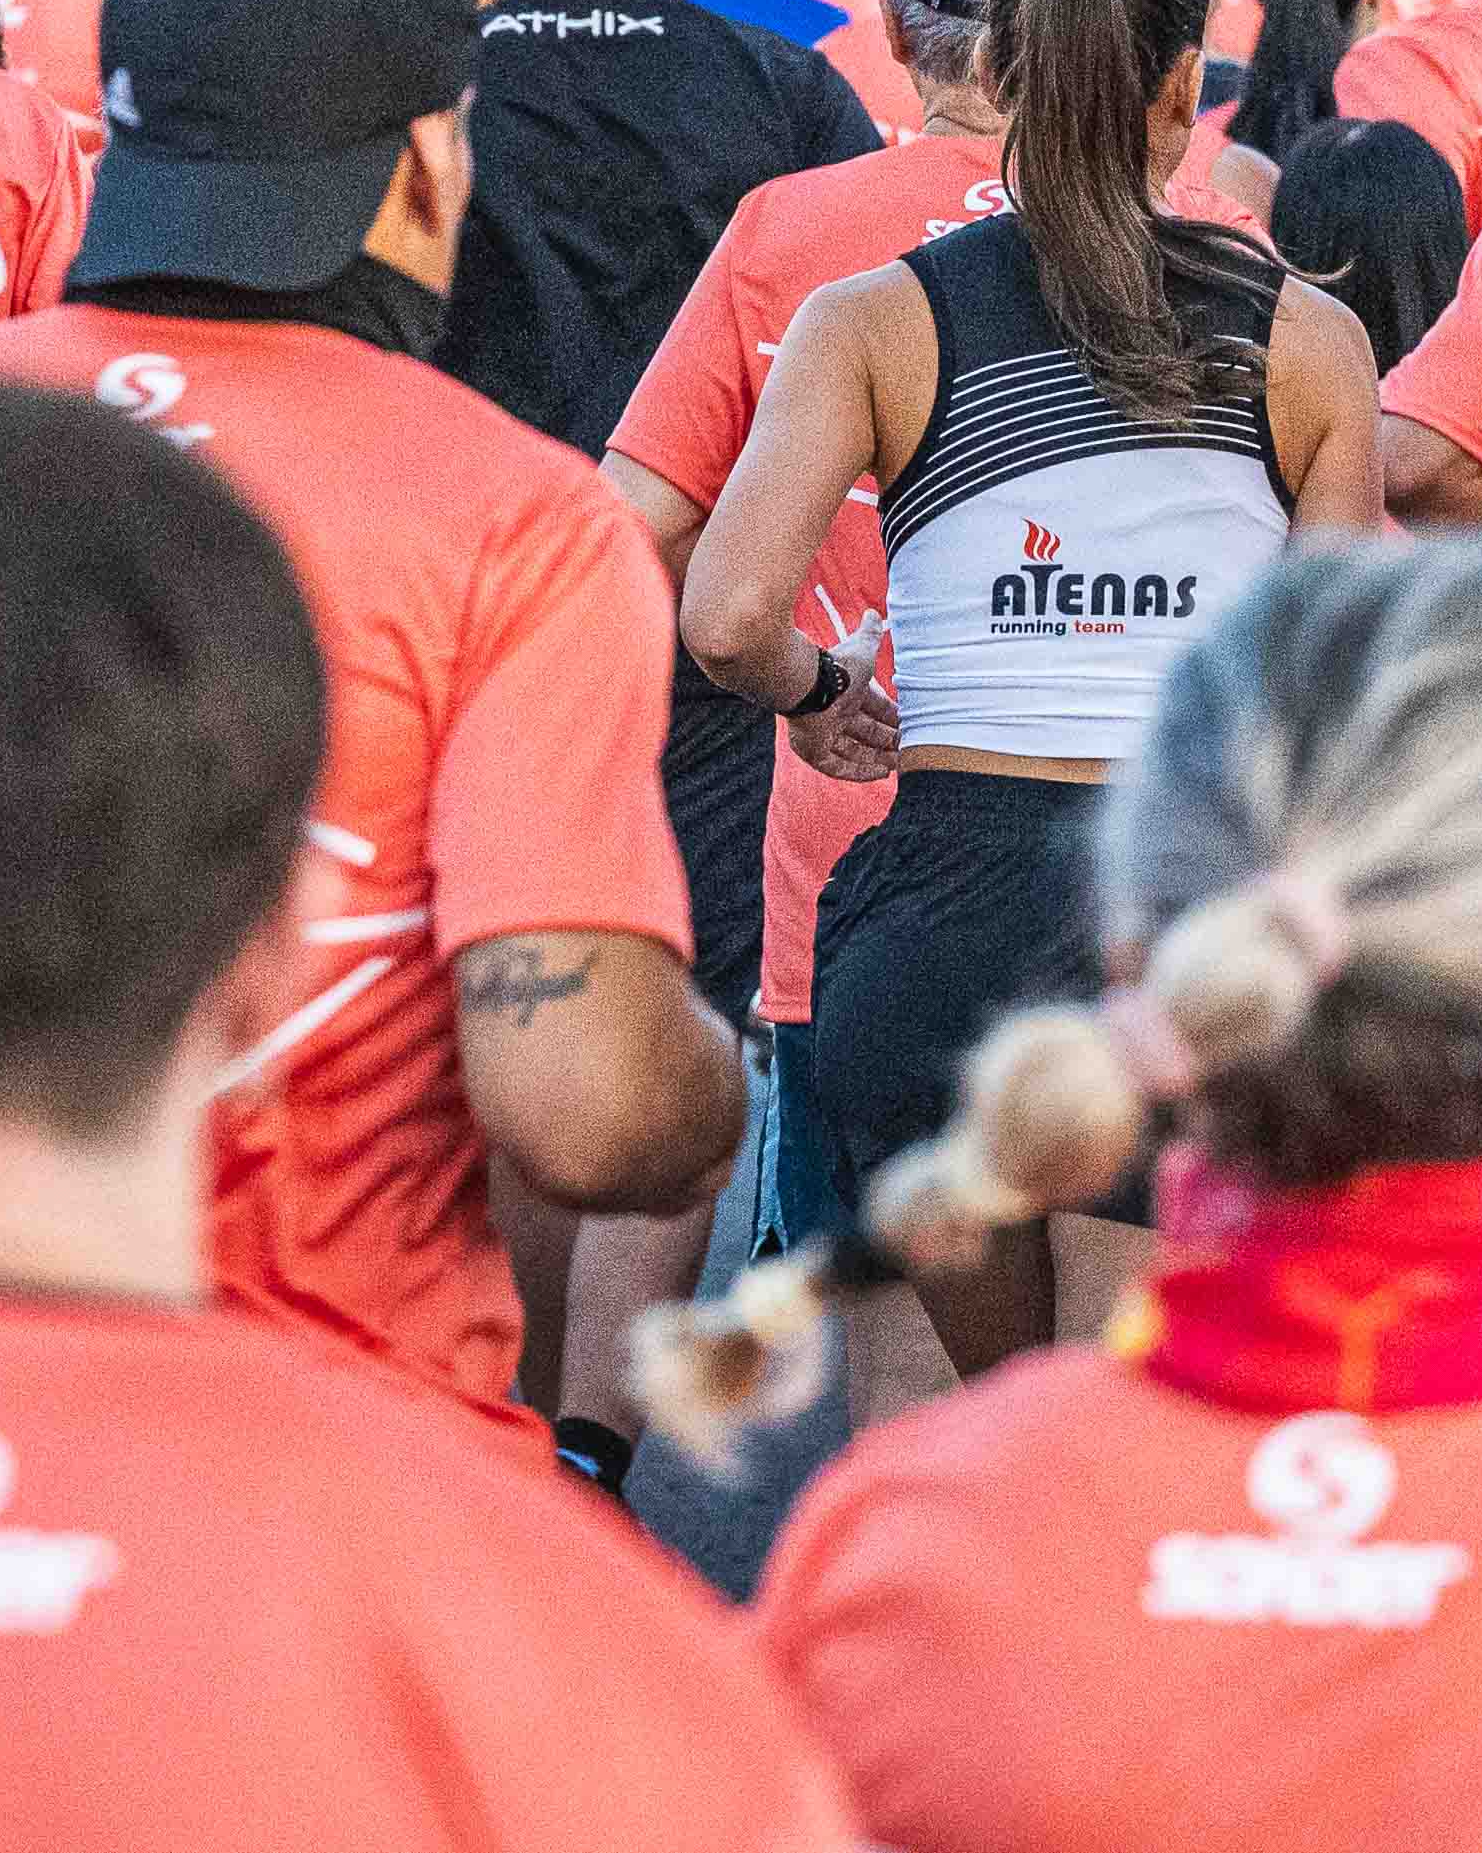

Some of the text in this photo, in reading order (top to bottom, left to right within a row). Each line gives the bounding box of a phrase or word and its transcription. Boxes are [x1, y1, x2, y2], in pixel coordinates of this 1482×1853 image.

[480, 8, 665, 40] ATHIX
[991, 564, 1198, 618] ATENAS
[991, 619, 1125, 636] running team
